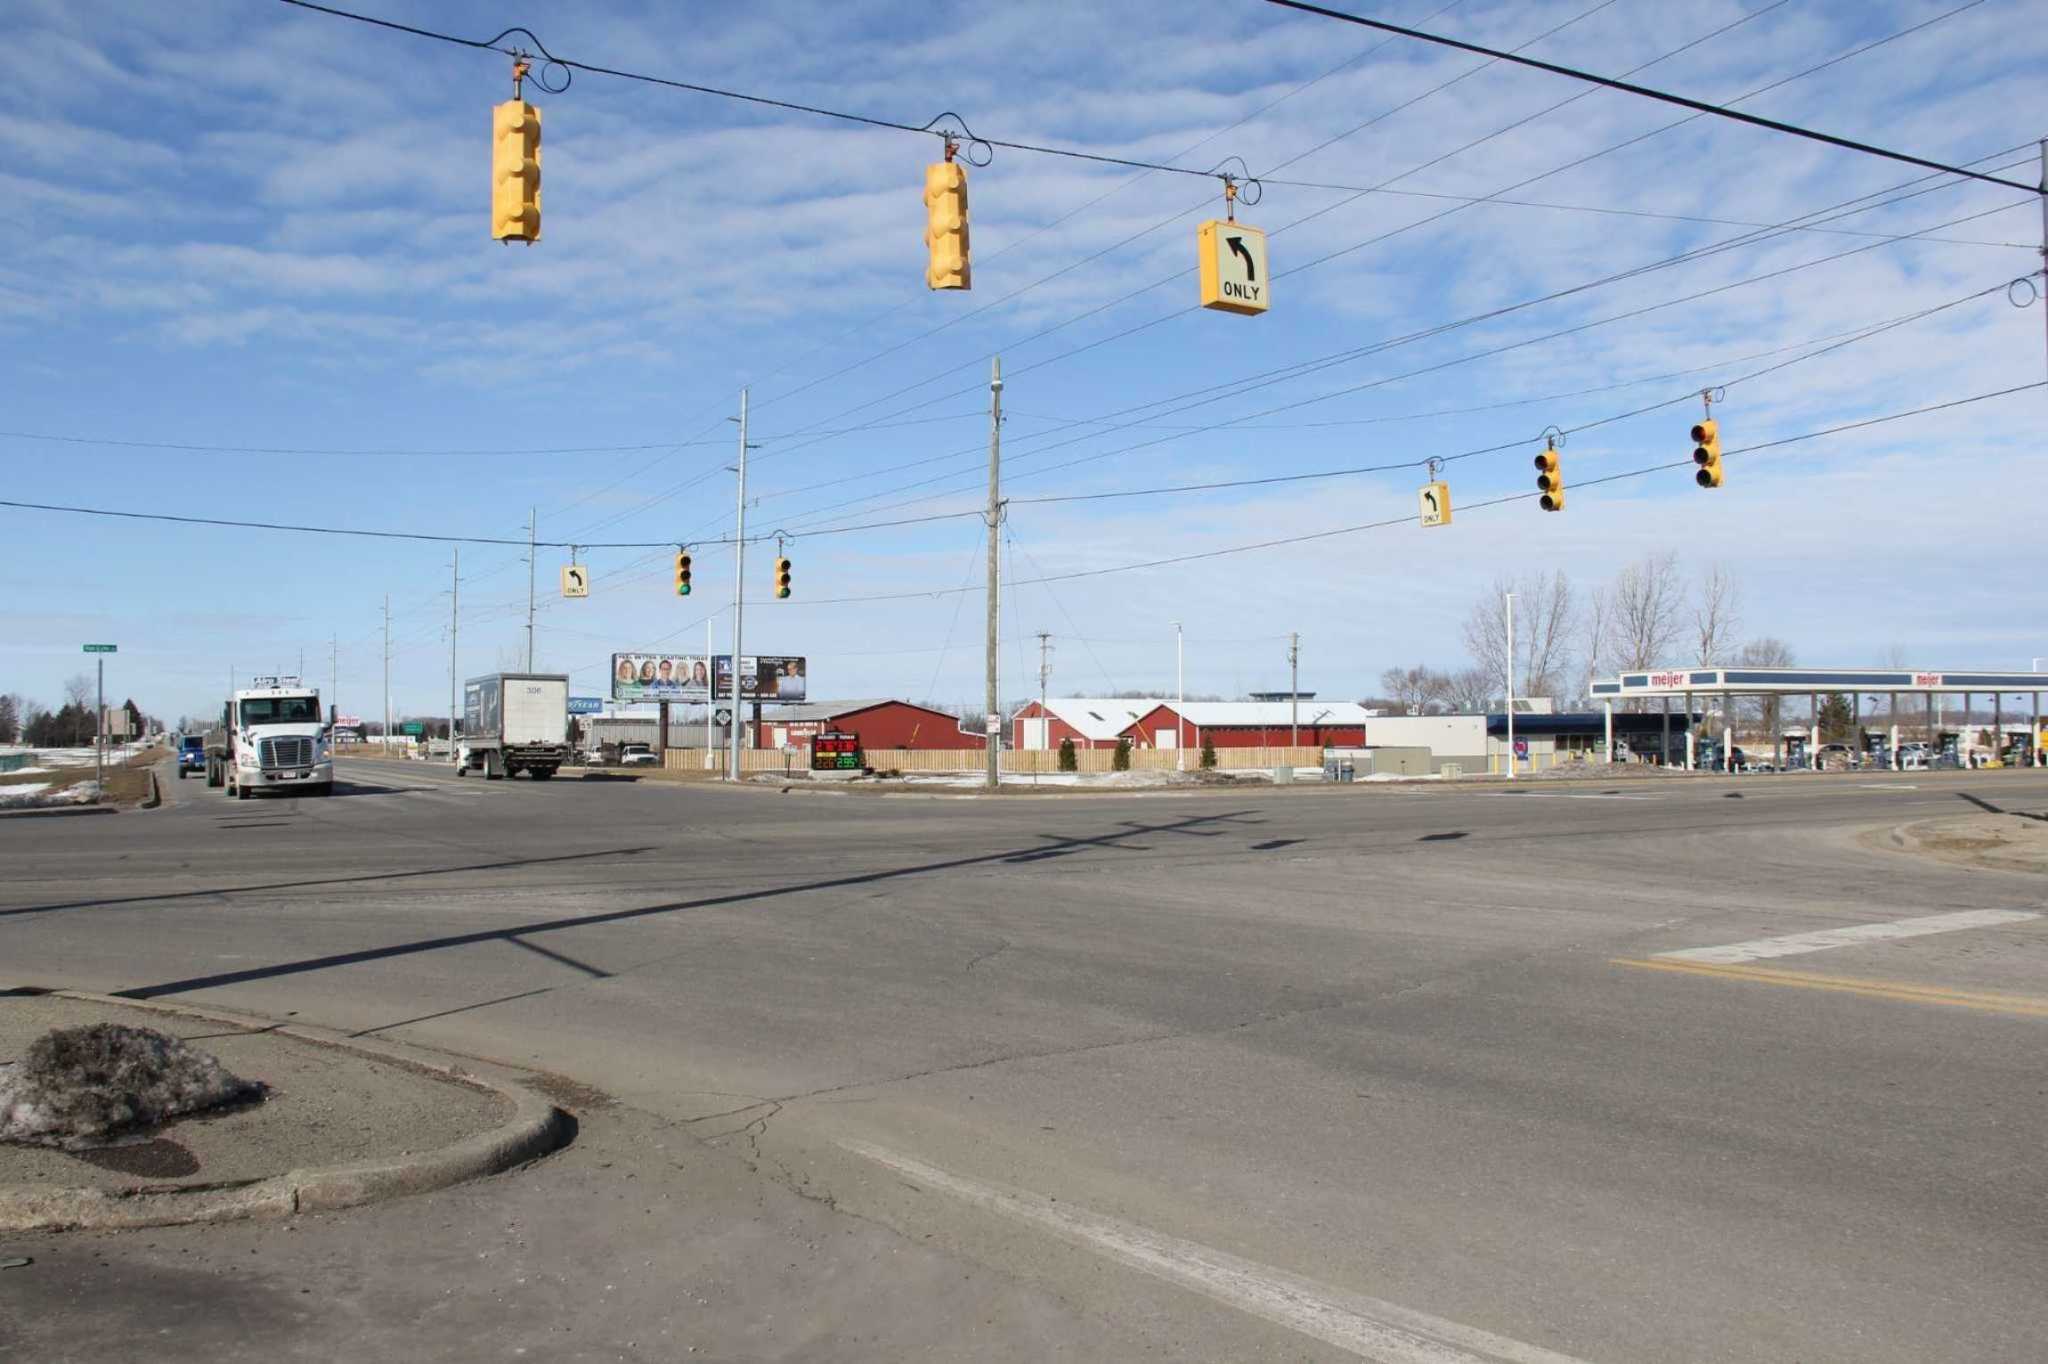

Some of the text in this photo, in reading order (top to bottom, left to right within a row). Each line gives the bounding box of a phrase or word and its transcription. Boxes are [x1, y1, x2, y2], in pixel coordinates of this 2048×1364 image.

[1224, 281, 1260, 301] ONLY
[1423, 512, 1440, 523] ONLY
[1651, 672, 1684, 688] meijer
[1917, 673, 1939, 687] meijer
